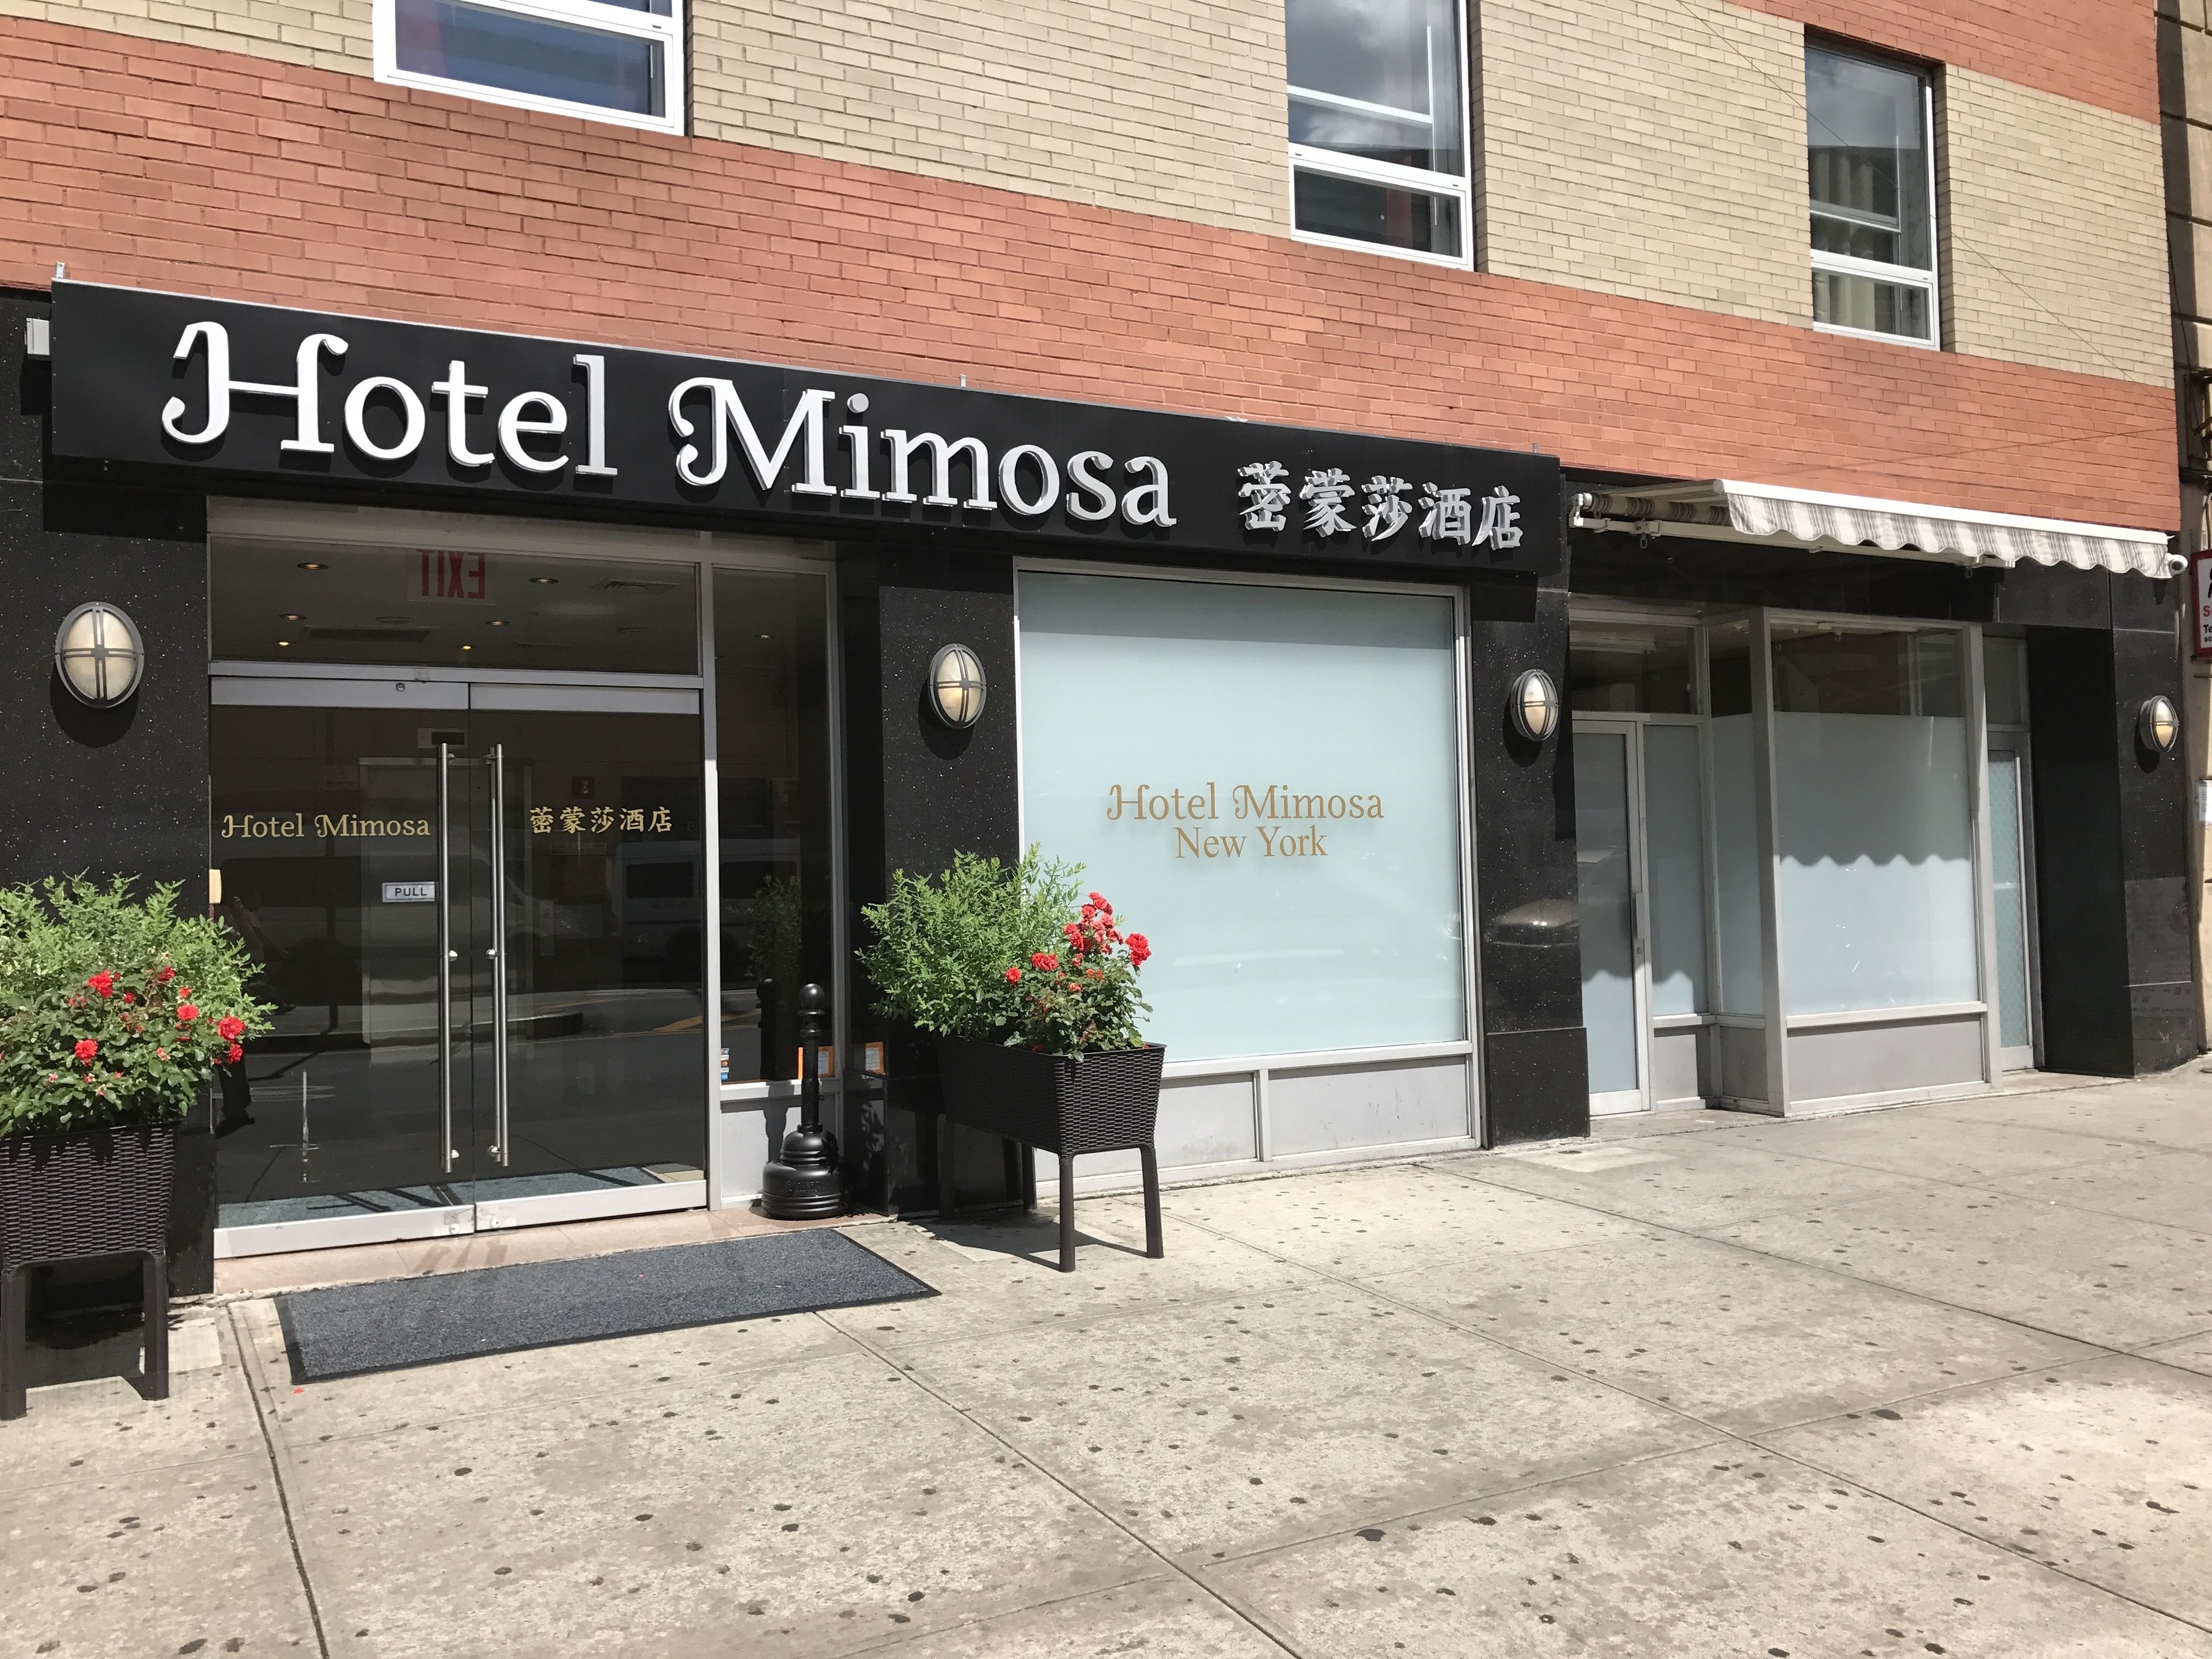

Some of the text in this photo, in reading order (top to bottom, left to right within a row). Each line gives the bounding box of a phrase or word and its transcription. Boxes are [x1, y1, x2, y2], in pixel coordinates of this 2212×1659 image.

[162, 321, 1177, 527] Hotel Mimosa
[1106, 782, 1385, 821] Hotel Mimosa
[221, 813, 431, 838] Hotel Mimosa
[1173, 824, 1329, 859] New York
[395, 887, 427, 897] PULL
